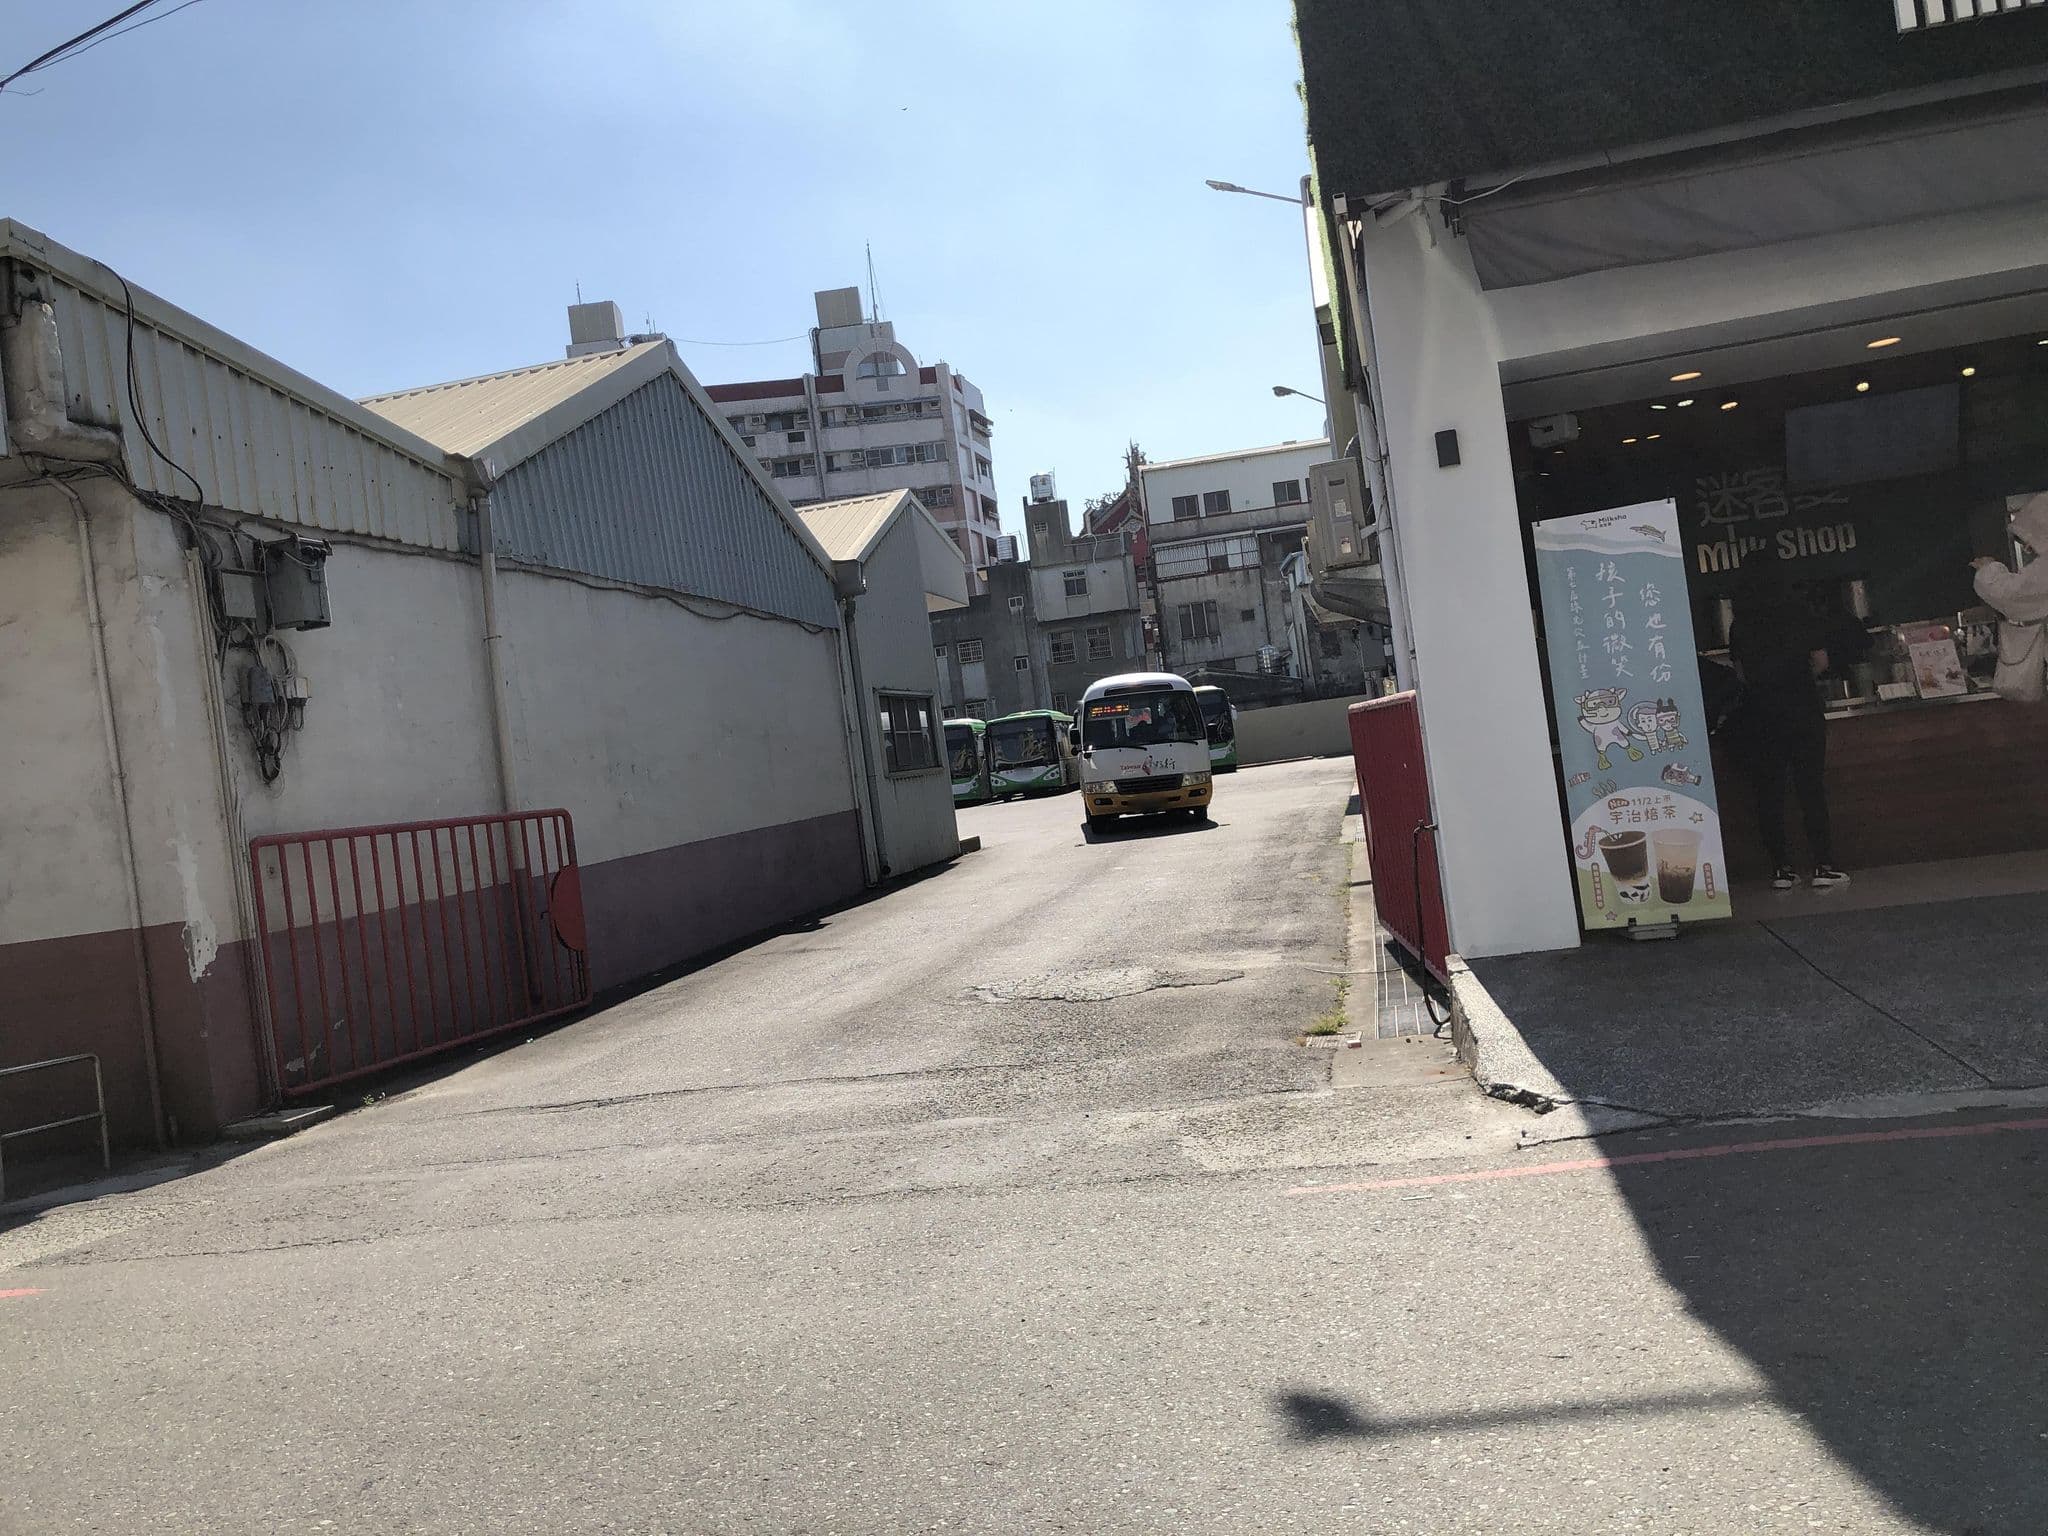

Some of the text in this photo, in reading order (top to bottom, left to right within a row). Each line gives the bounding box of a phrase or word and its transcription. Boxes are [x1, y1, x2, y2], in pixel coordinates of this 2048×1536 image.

[1598, 514, 1627, 524] Milksha
[1776, 521, 1857, 560] Shop
[1595, 561, 1634, 678] 孩子的微笑
[1639, 582, 1672, 683] 您也有份
[1609, 805, 1677, 824] 宇治焙茶
